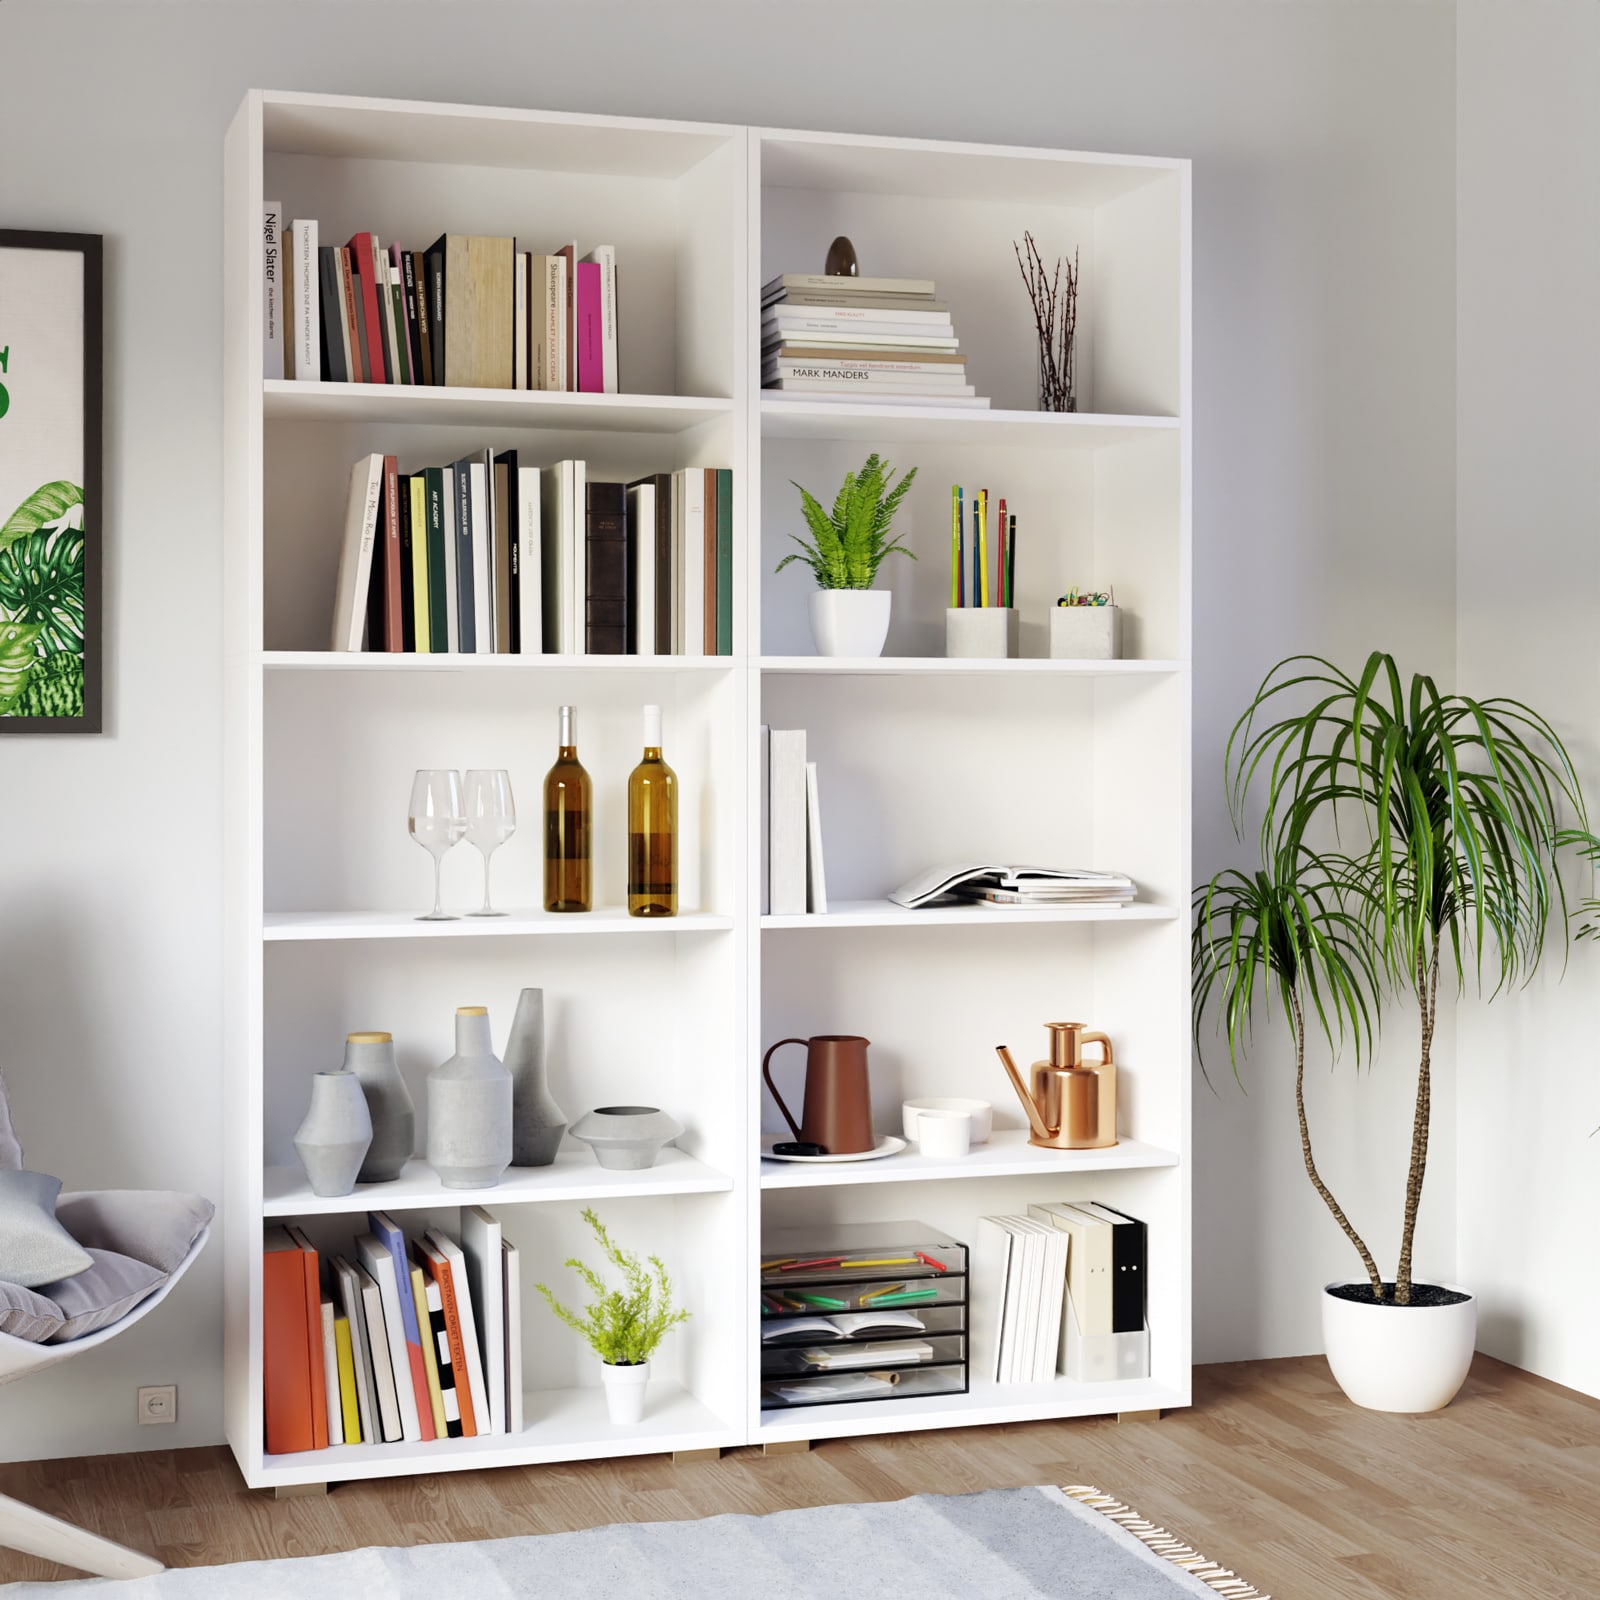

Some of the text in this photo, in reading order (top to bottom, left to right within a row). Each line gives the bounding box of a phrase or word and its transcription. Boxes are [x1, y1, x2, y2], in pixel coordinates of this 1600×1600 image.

[264, 213, 277, 244] Nigel
[265, 248, 278, 283] Slater
[549, 263, 559, 308] Shakespeare
[268, 298, 276, 319] kitchen
[792, 368, 869, 380] MARK MANDERS
[442, 1269, 463, 1372] BOKSTAVEN ORDET TEXTEN
